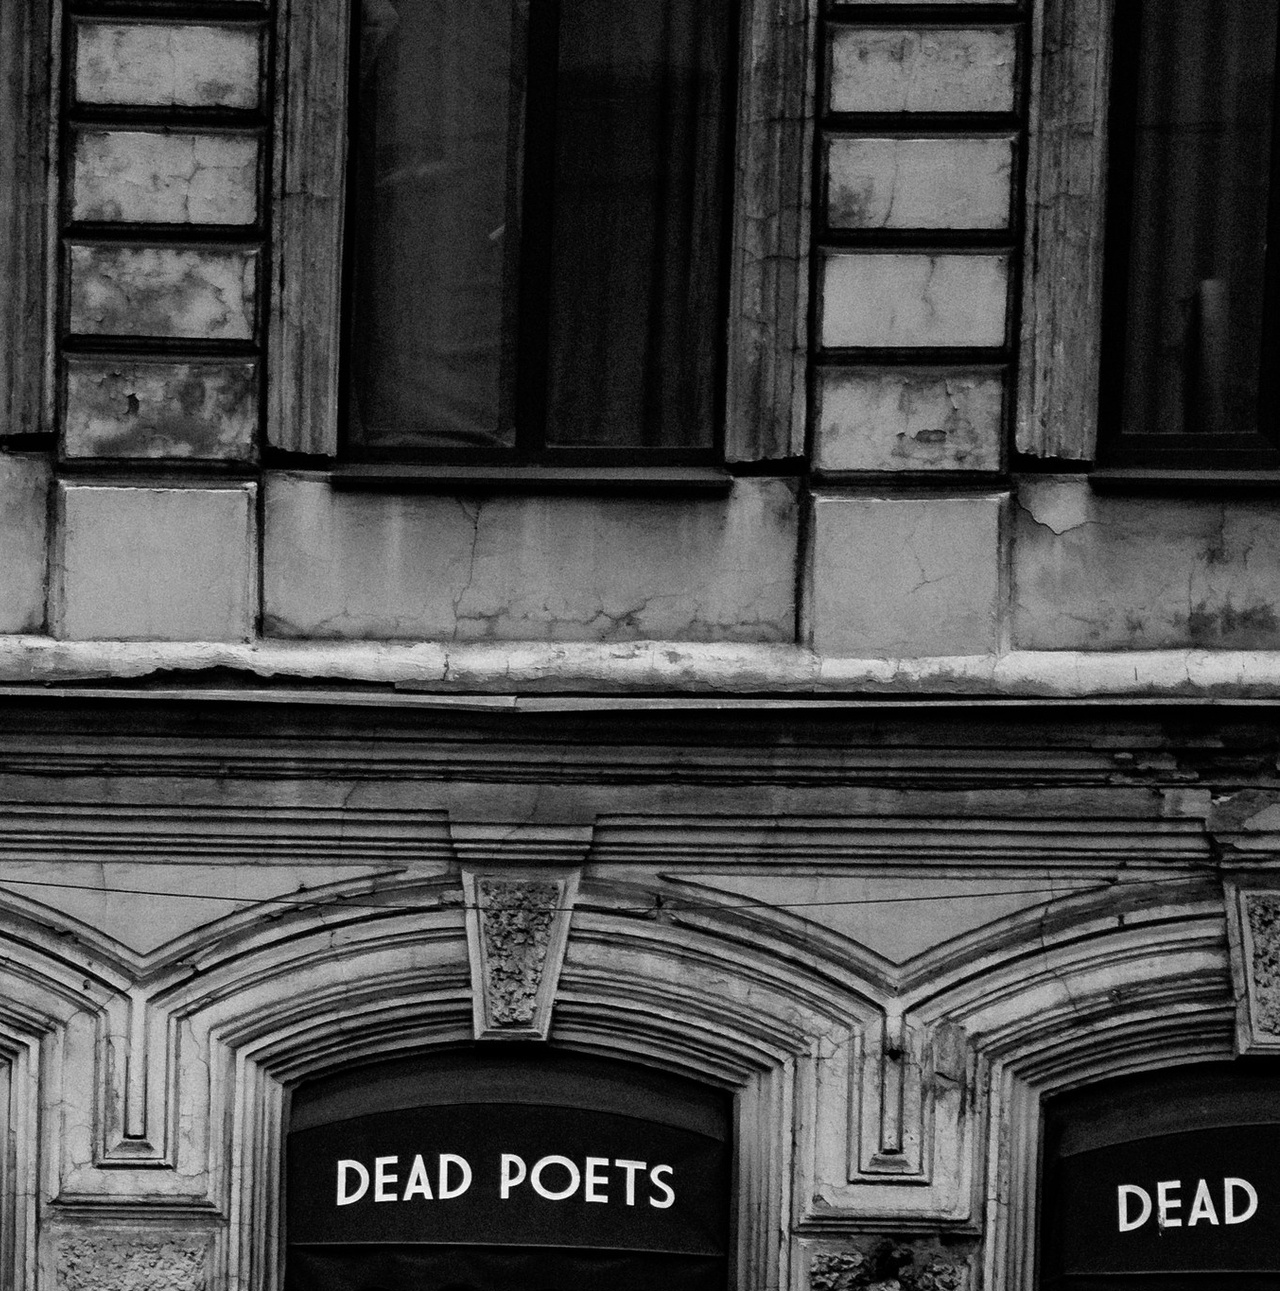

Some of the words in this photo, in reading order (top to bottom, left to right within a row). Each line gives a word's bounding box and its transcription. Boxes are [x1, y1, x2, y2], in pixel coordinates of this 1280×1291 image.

[336, 1153, 473, 1206] DEAD
[500, 1153, 676, 1209] POETS
[1117, 1177, 1259, 1233] DEAD
